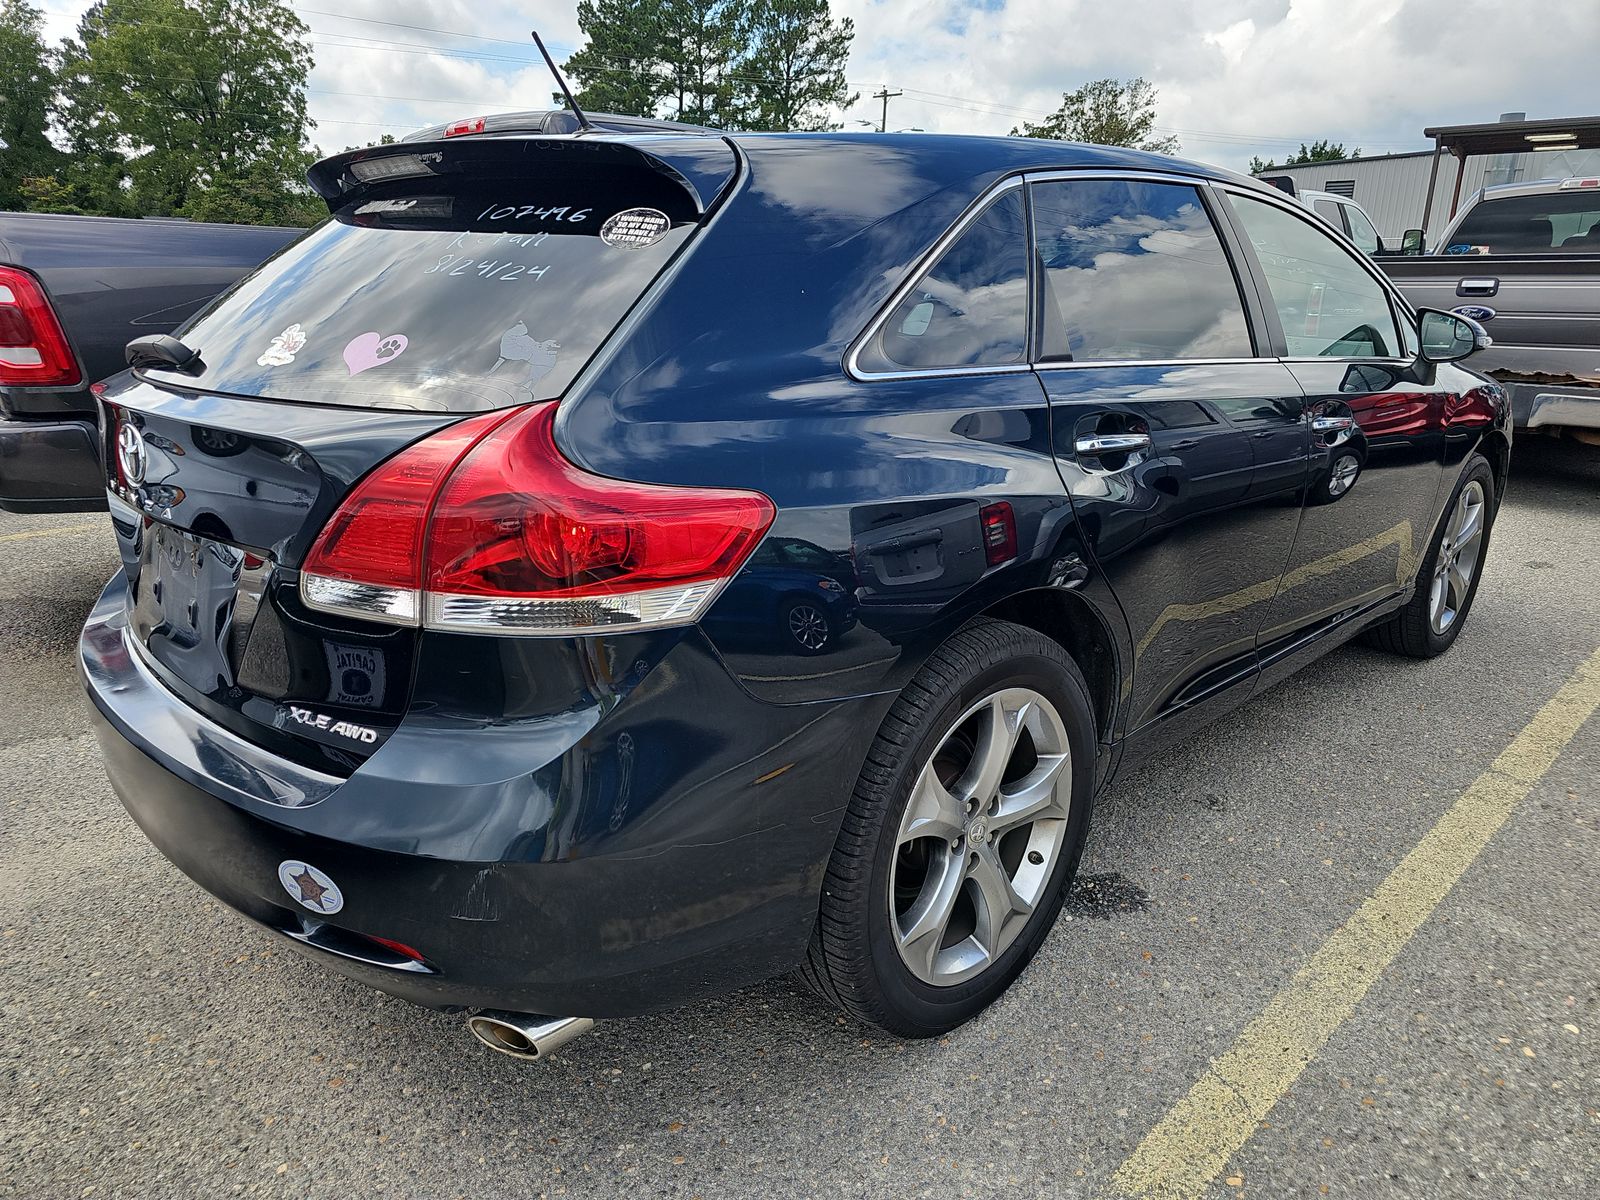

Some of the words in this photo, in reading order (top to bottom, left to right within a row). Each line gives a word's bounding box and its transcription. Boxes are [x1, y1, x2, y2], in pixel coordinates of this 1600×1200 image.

[477, 202, 592, 223] 107496
[424, 254, 551, 282] 8/24/24
[1460, 307, 1485, 319] Ford
[287, 706, 332, 730] XLE
[329, 721, 378, 744] AWD
